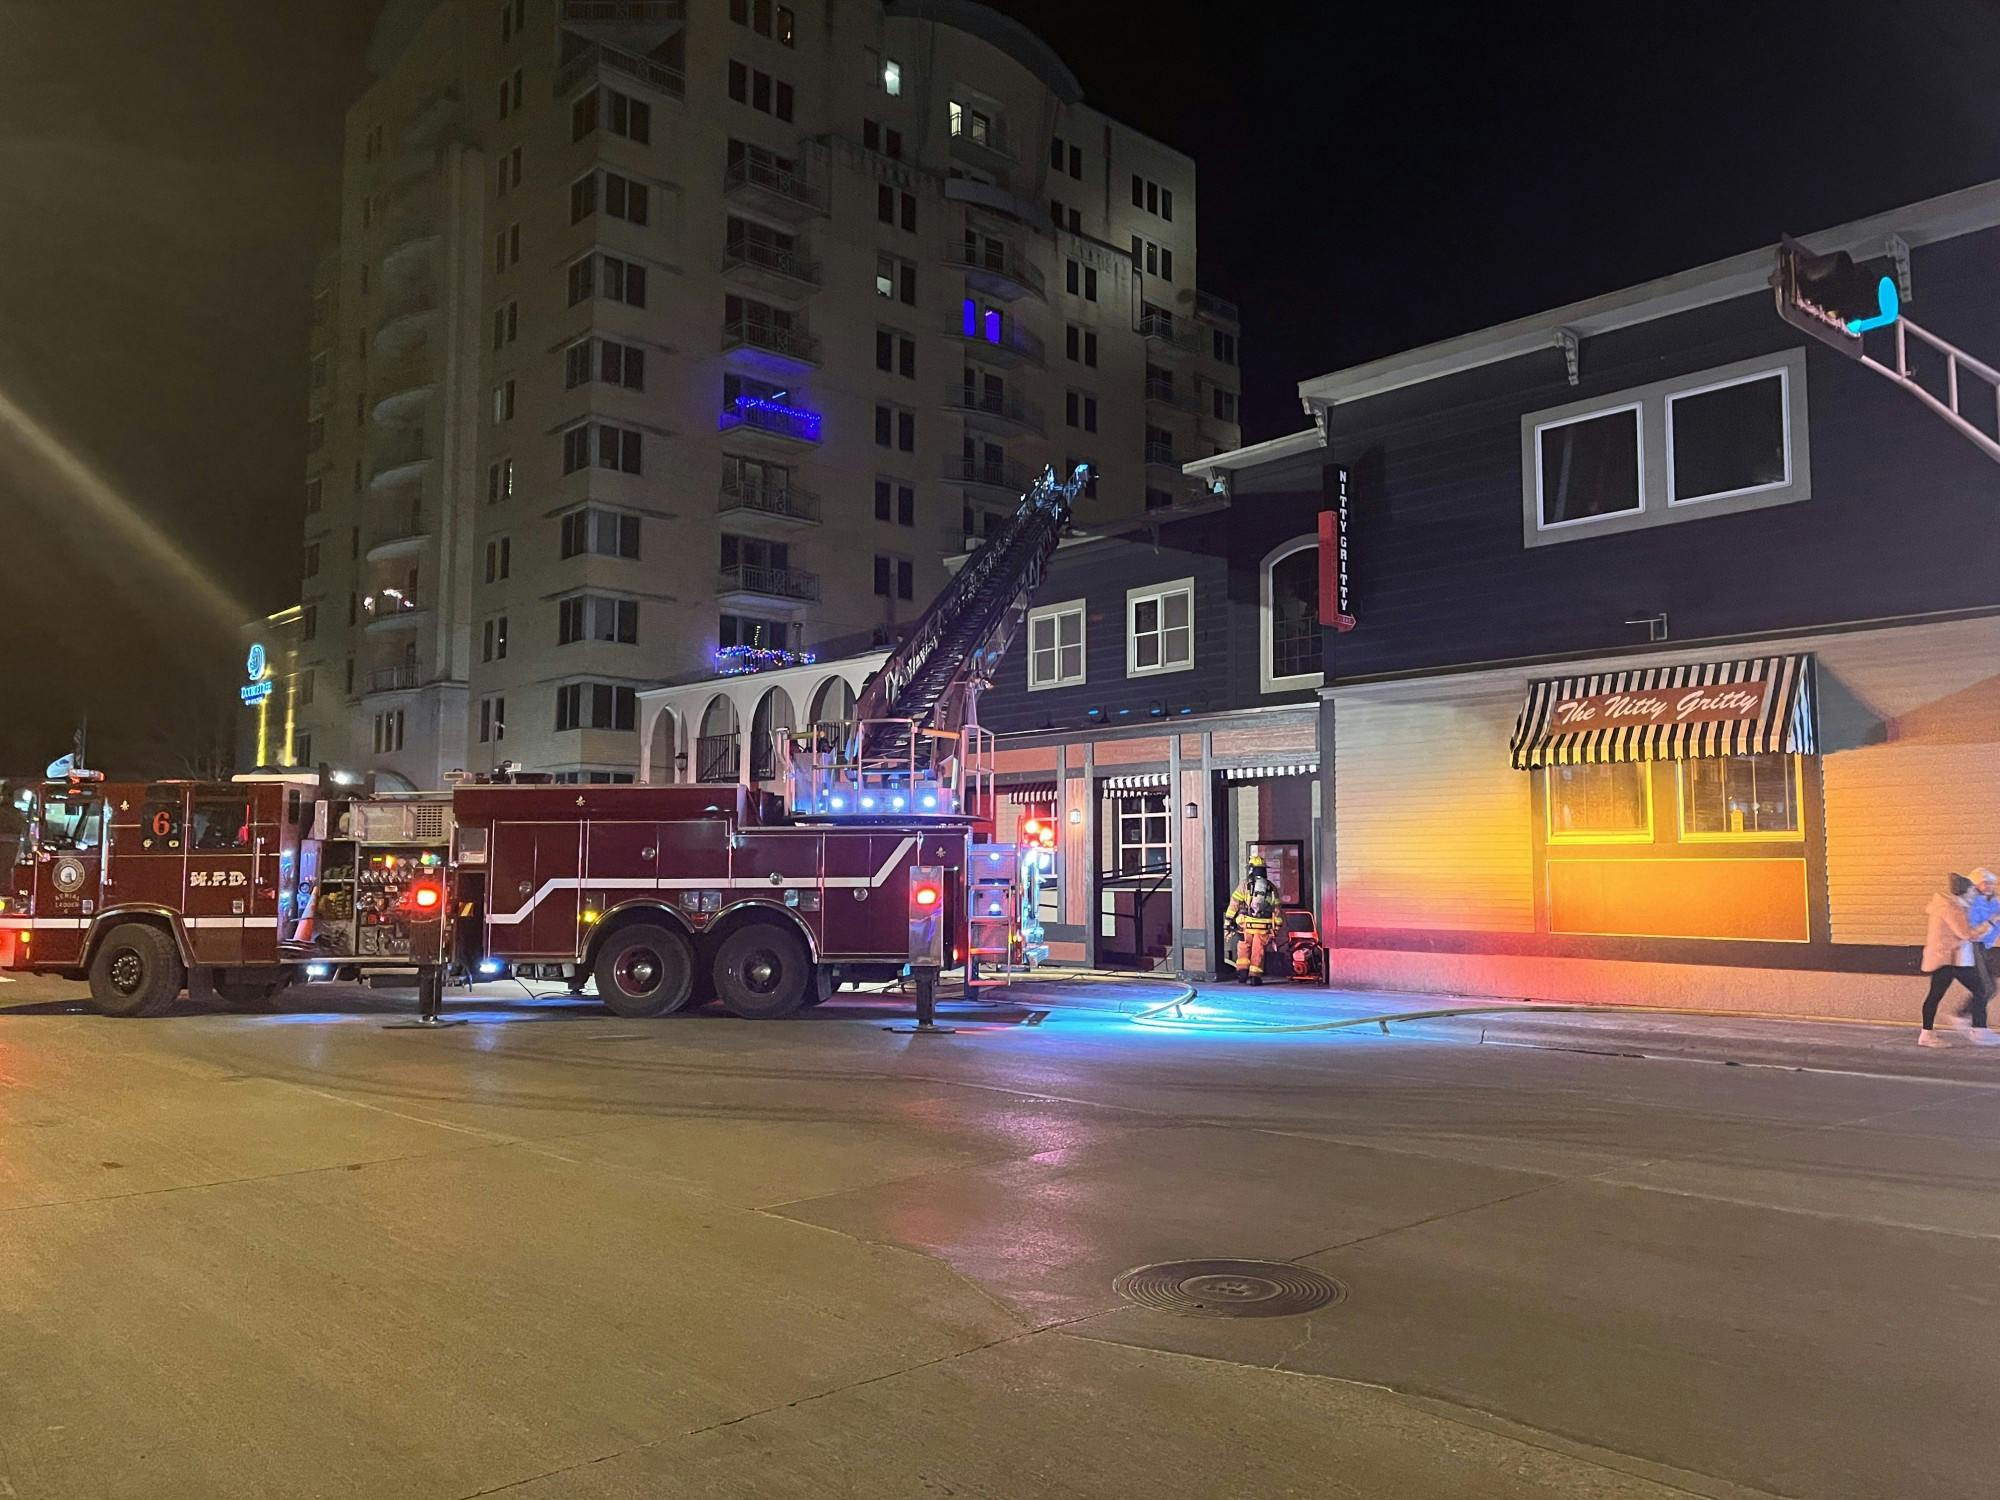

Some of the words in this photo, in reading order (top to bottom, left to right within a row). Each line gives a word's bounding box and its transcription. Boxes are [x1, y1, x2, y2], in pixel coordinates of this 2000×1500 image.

[1339, 470, 1347, 533] NITTY
[1340, 536, 1348, 611] GRITTY
[1557, 701, 1596, 725] The
[1604, 695, 1668, 721] Nitty
[1676, 690, 1758, 720] Gritty
[153, 811, 170, 835] 6
